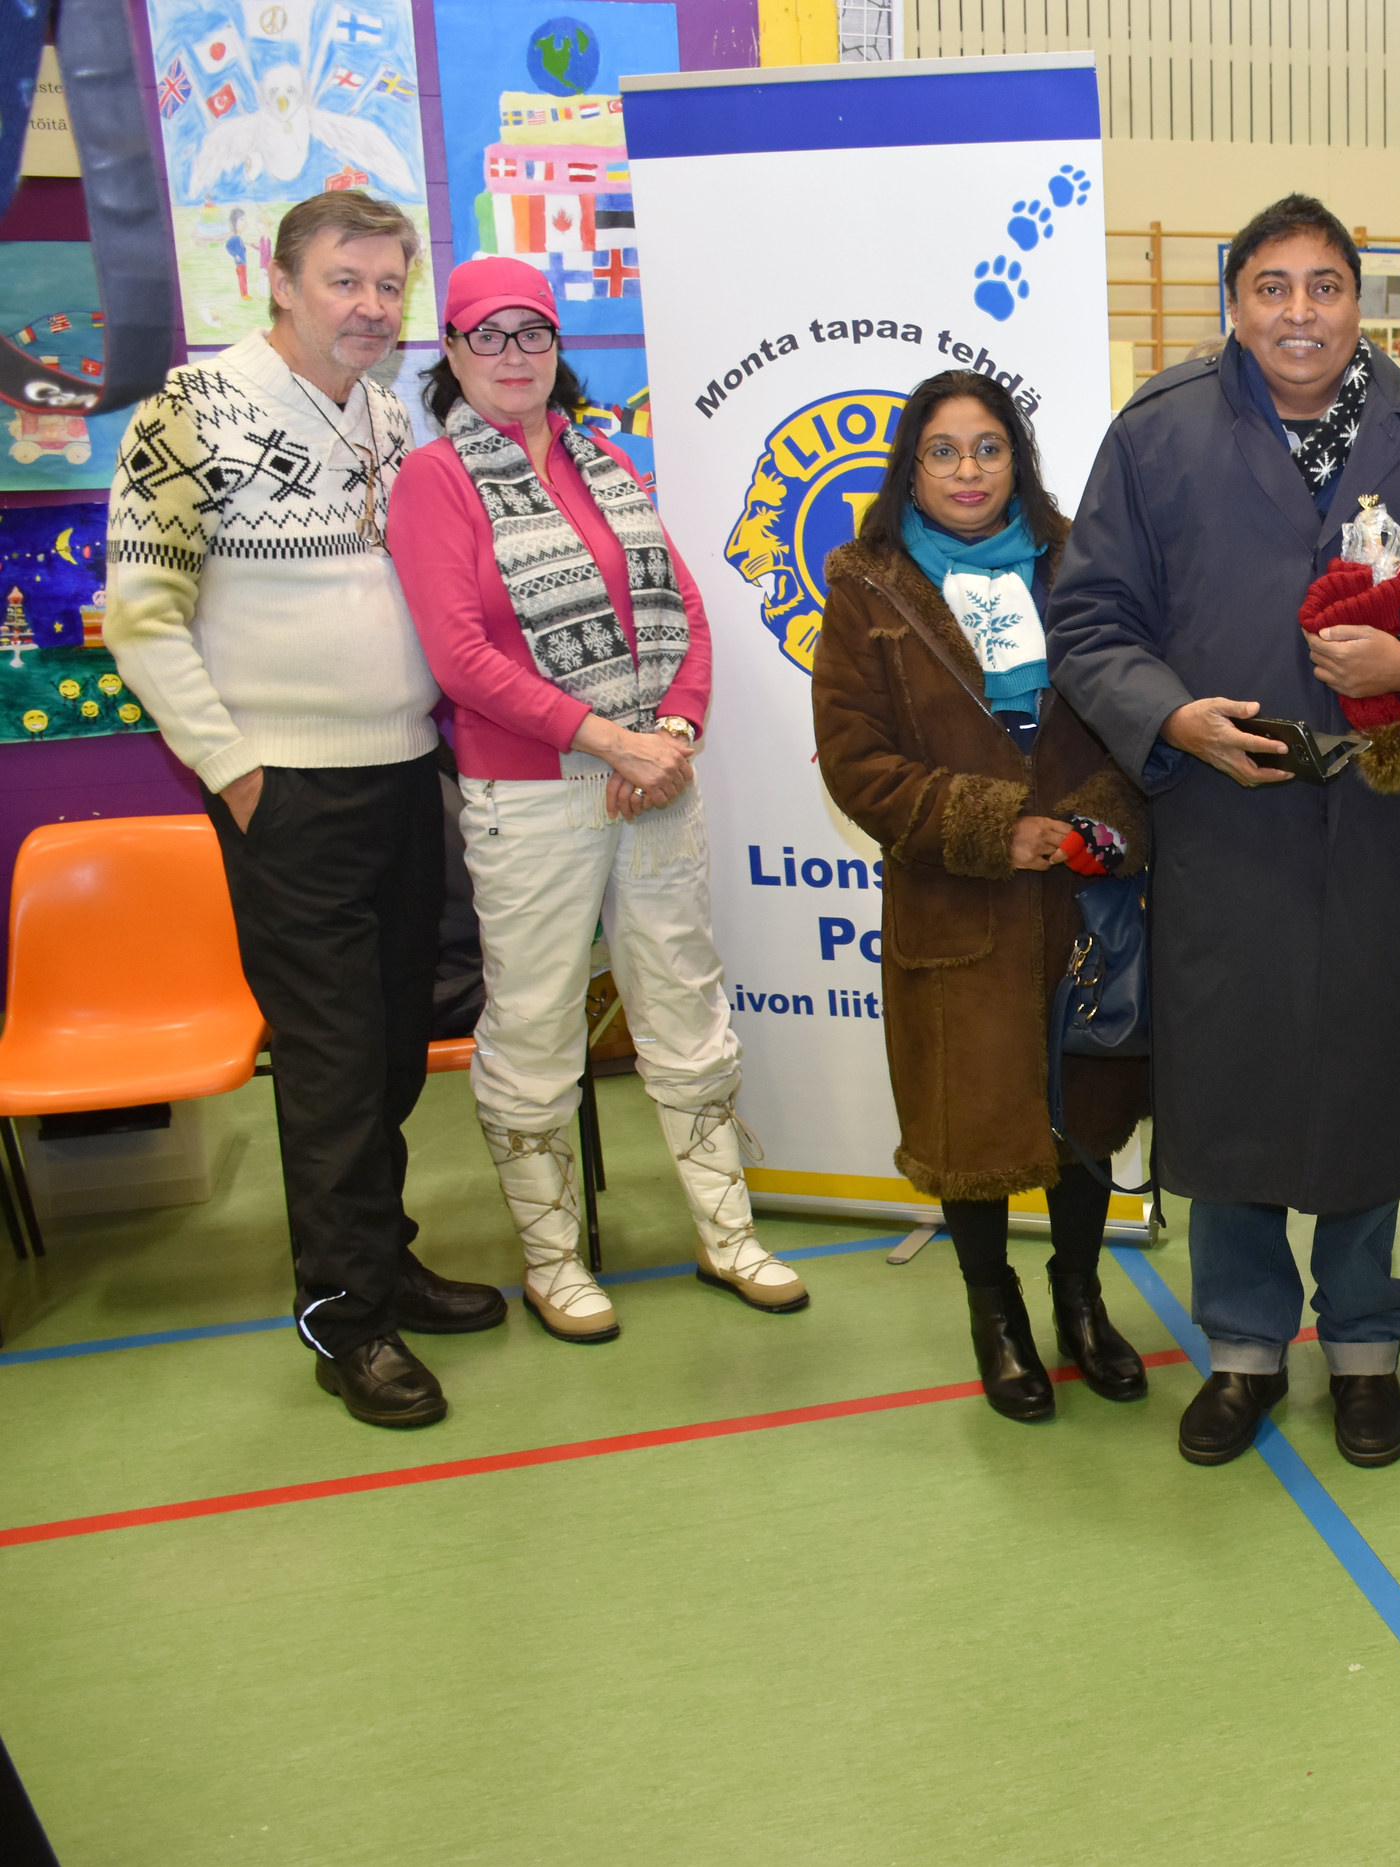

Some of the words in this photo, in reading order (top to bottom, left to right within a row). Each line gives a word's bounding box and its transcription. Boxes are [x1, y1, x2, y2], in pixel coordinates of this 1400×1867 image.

[694, 332, 800, 420] Monta
[809, 318, 923, 345] tapaa
[937, 329, 1043, 417] tehdä
[729, 984, 815, 1016] ivon
[827, 989, 885, 1020] liit
